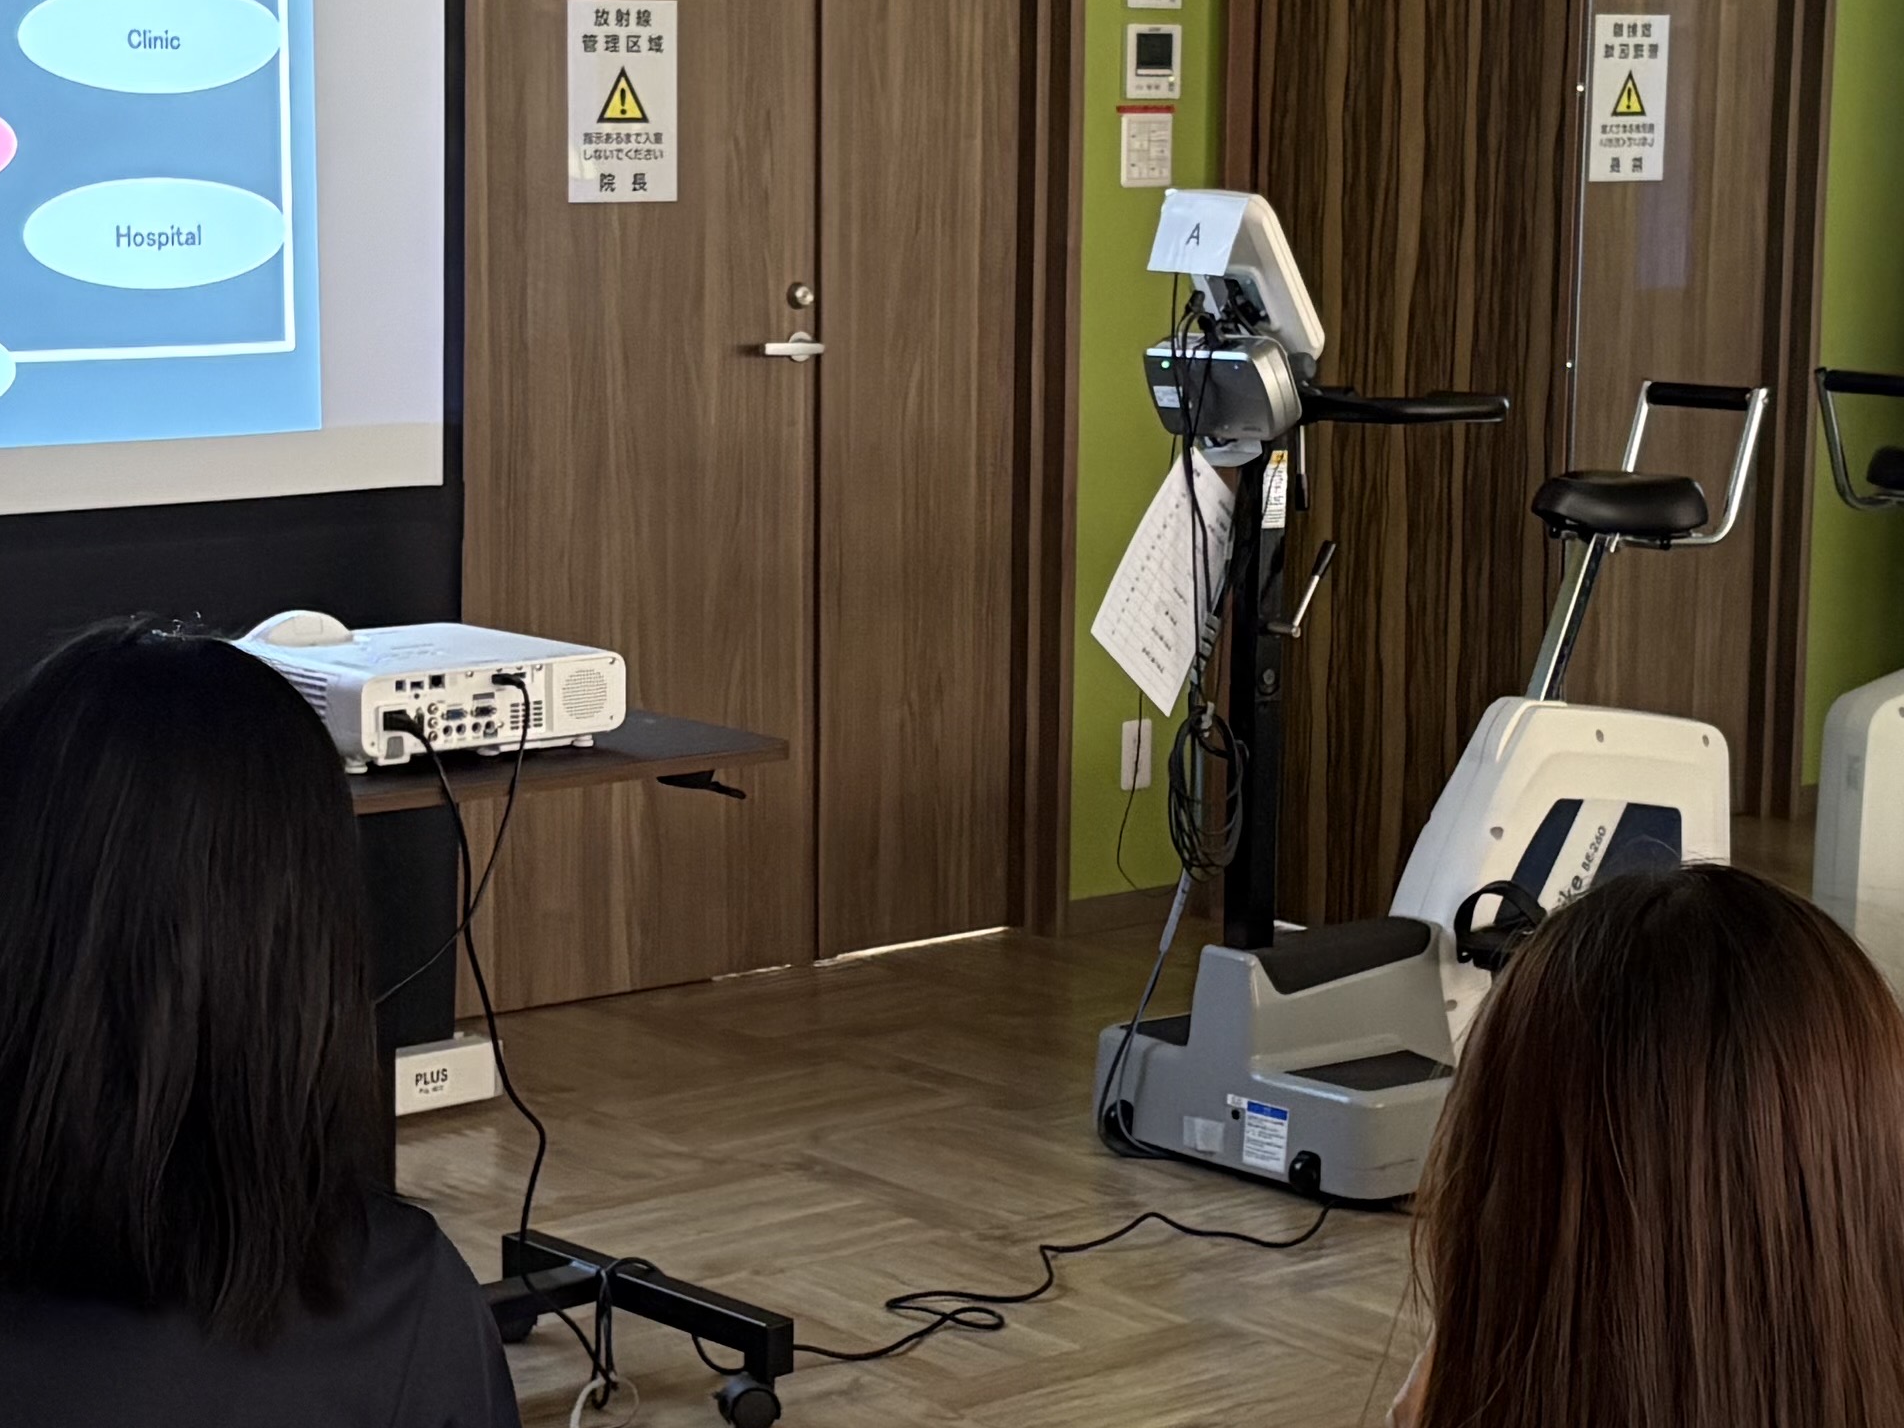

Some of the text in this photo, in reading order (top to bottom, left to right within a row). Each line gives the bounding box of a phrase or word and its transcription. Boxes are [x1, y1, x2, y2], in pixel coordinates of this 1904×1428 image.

[594, 9, 651, 27] 放射線
[128, 29, 180, 49] Clinic
[582, 34, 663, 53] 管理区域
[116, 224, 201, 250] Hospital
[1185, 223, 1201, 247] A
[415, 1067, 448, 1087] PLUS
